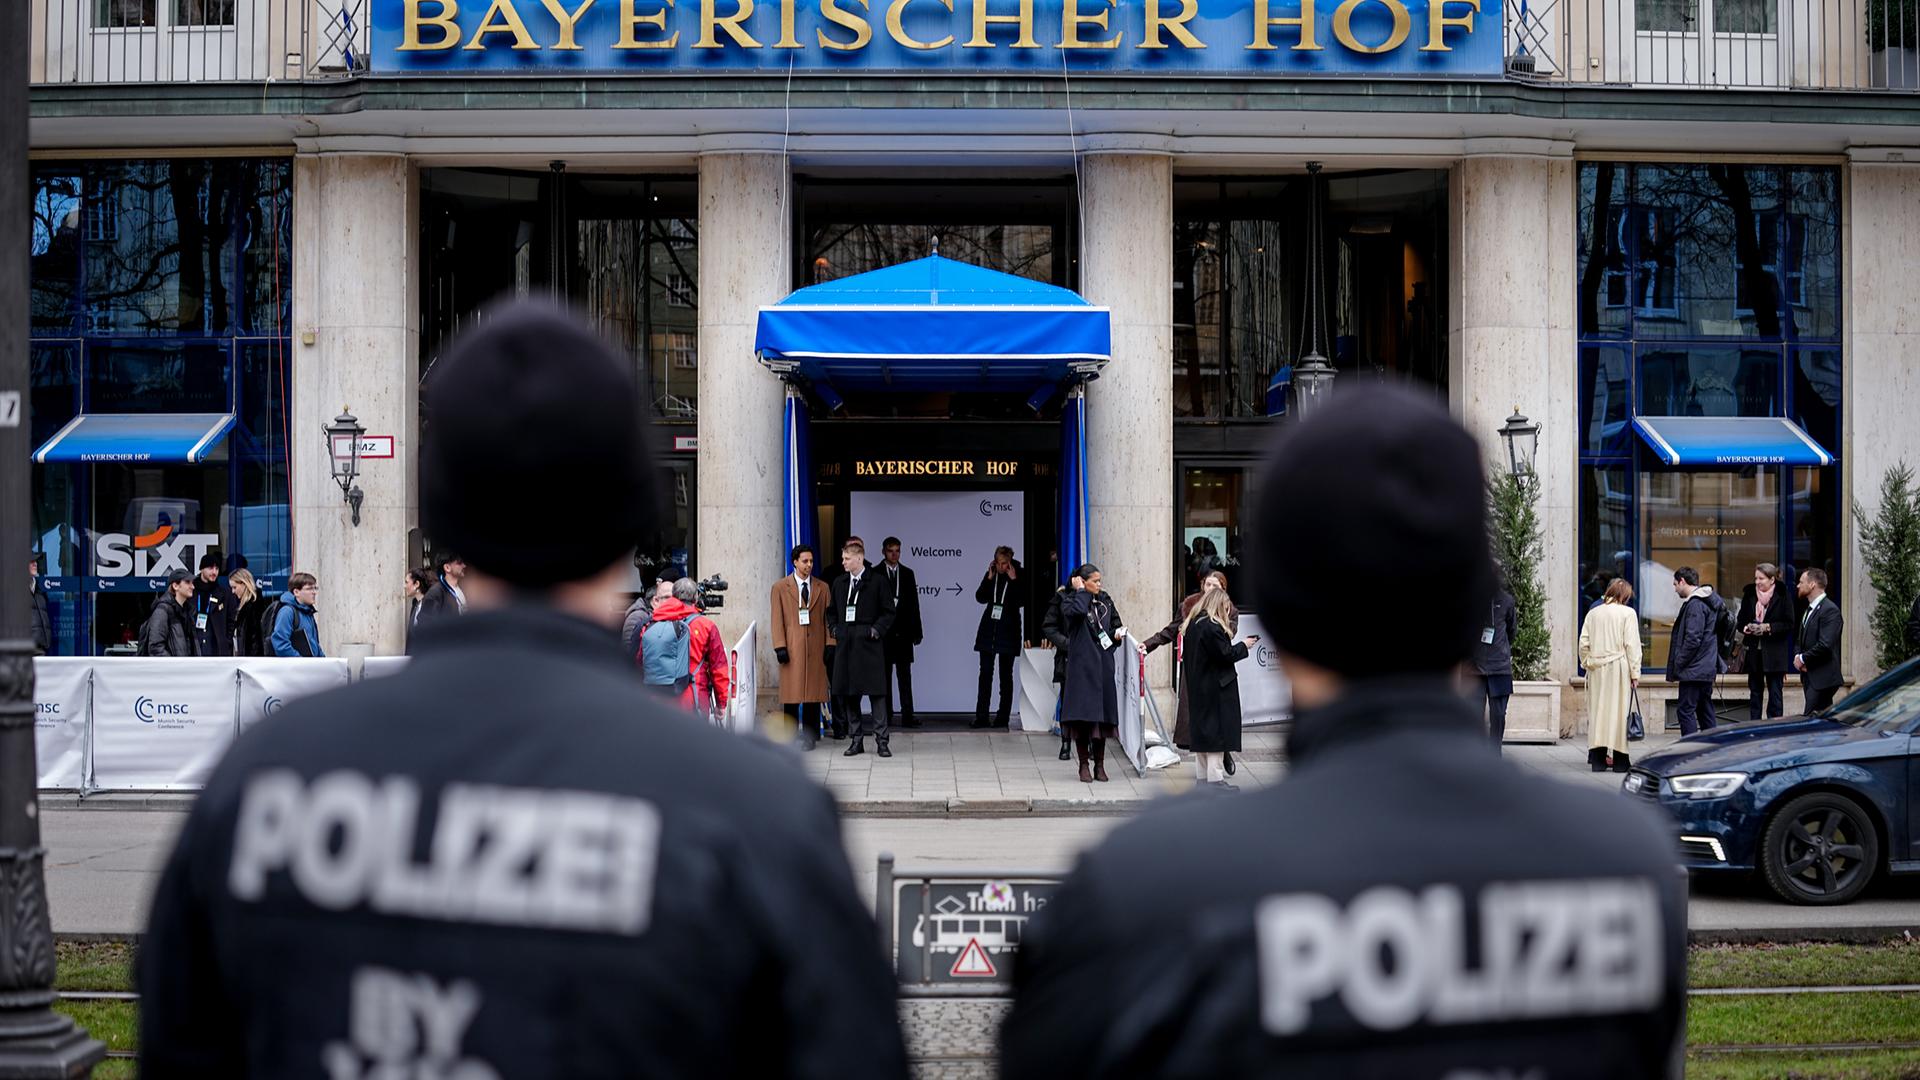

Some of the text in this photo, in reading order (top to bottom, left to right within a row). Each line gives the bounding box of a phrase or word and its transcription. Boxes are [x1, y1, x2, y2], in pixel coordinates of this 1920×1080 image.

[395, 0, 1481, 54] BAYERISCHER HOF
[81, 453, 151, 461] BAYERISCHER HOF
[1716, 455, 1785, 463] BAYERISCHER HOF
[856, 460, 1018, 475] BAYERISCHER HOF
[994, 502, 1013, 511] msc
[1693, 528, 1747, 536] LYNGGAARD
[911, 547, 962, 557] Welcome
[916, 585, 941, 596] ntry
[157, 704, 189, 714] msc
[229, 768, 661, 935] POLIZEI
[1256, 878, 1665, 1035] POLIZEI
[350, 967, 480, 1056] BY
